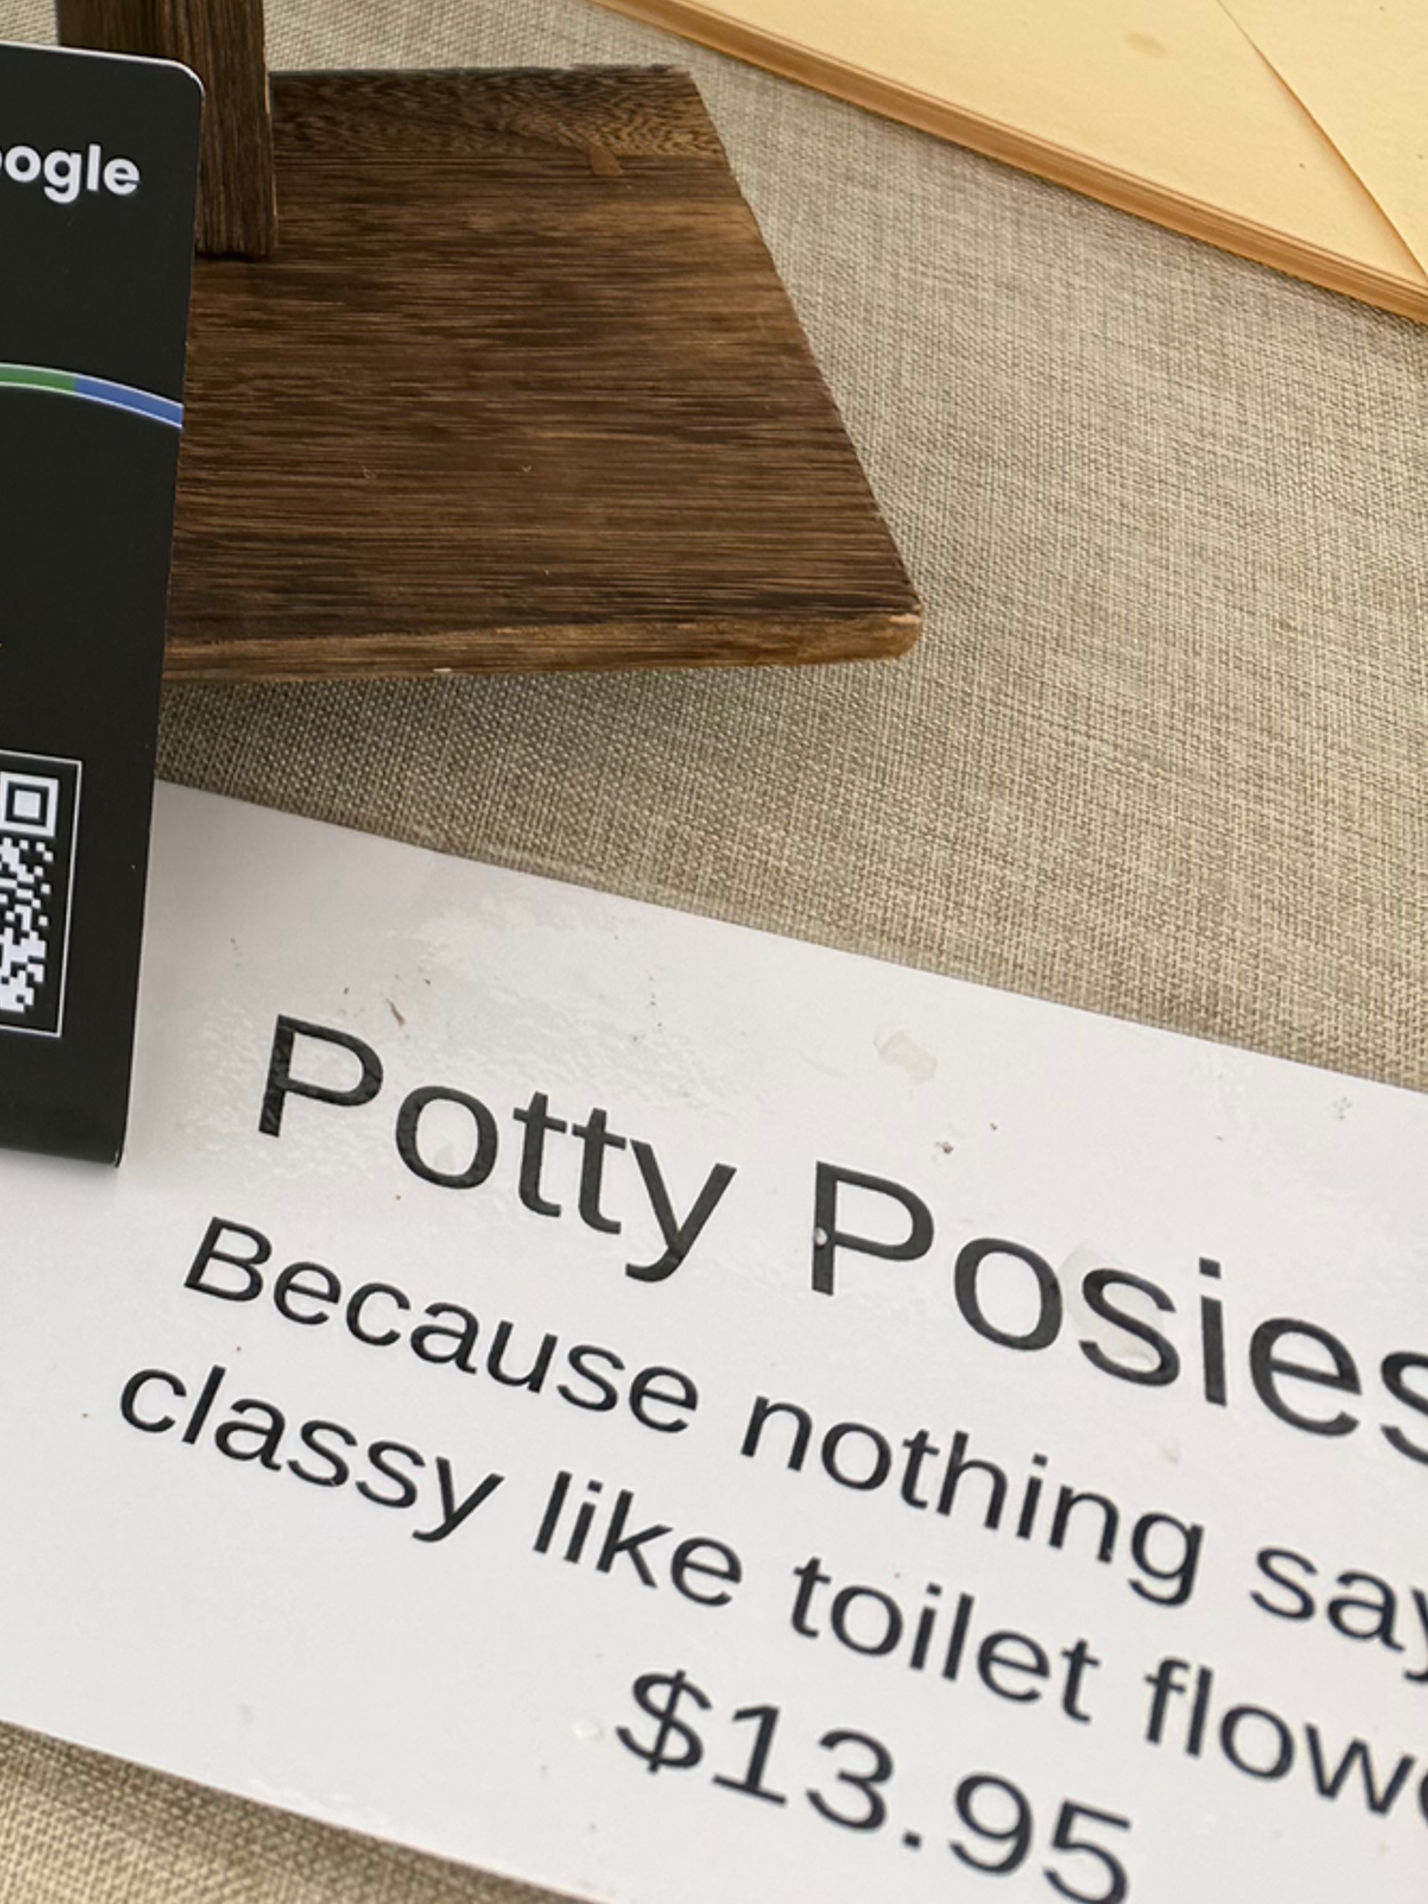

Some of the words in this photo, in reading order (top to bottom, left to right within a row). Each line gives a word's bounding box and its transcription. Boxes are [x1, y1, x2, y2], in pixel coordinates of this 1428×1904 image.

[256, 1012, 738, 1285] Potty
[118, 1364, 505, 1545] classy
[532, 1469, 743, 1608] like
[790, 1556, 1101, 1724] toilet
[1143, 1655, 1428, 1828] flow
[182, 1215, 700, 1435] Because
[739, 1395, 1206, 1608] nothing
[1249, 1546, 1428, 1684] sa
[615, 1669, 1134, 1904] $13.95
